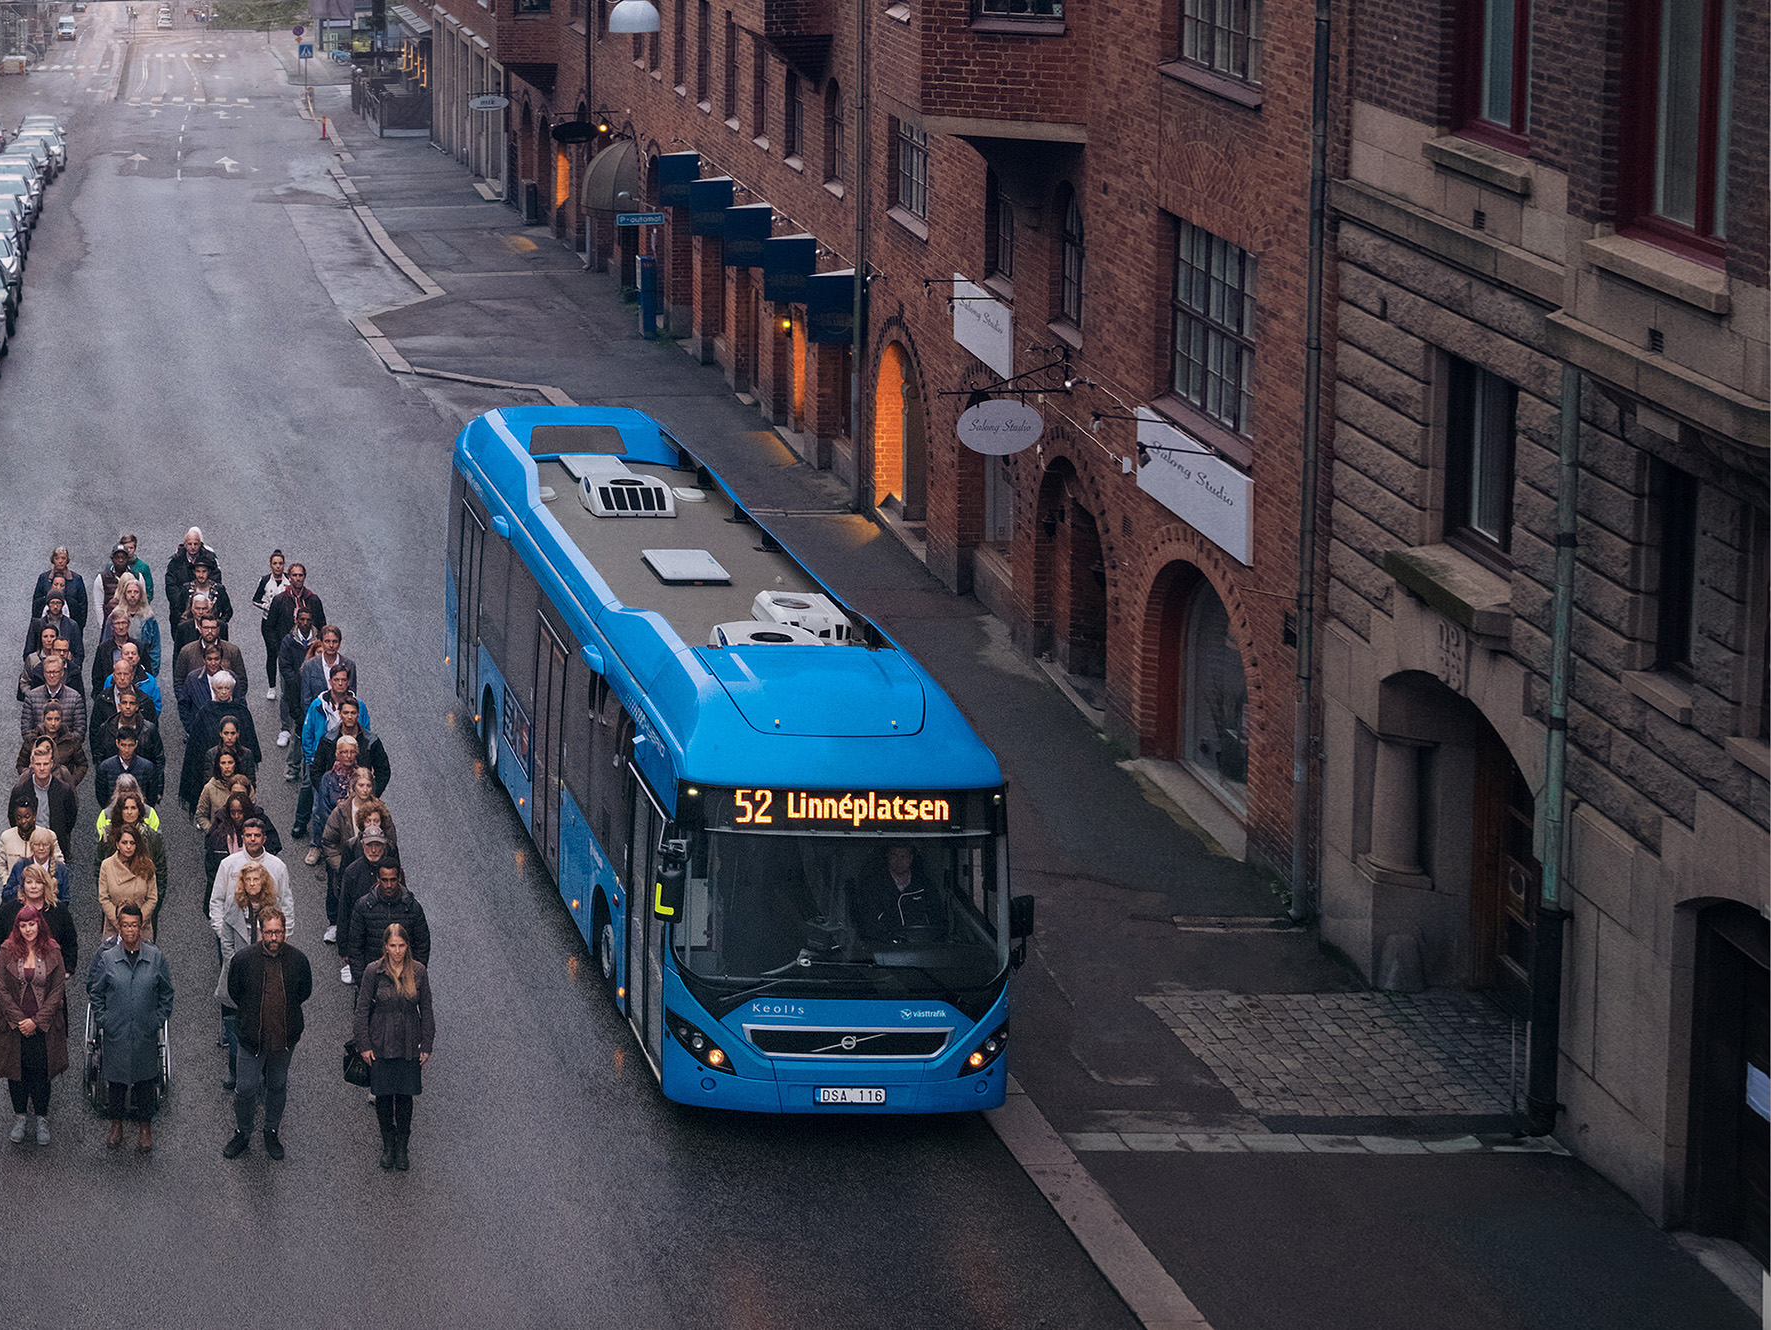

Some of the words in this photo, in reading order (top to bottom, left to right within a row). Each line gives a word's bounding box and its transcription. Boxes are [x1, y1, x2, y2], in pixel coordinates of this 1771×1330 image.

[959, 295, 981, 321] Salong
[982, 311, 1003, 334] Studio
[968, 419, 1000, 434] Salong
[1002, 419, 1031, 432] Studio
[1150, 441, 1191, 479] Salong
[1195, 472, 1233, 506] Studio
[735, 789, 773, 823] 52
[787, 792, 949, 827] Linnéplatsen
[752, 1003, 805, 1014] Keolis
[912, 1009, 947, 1018] västtrafik
[822, 1089, 847, 1101] DSA
[859, 1089, 883, 1102] 116
